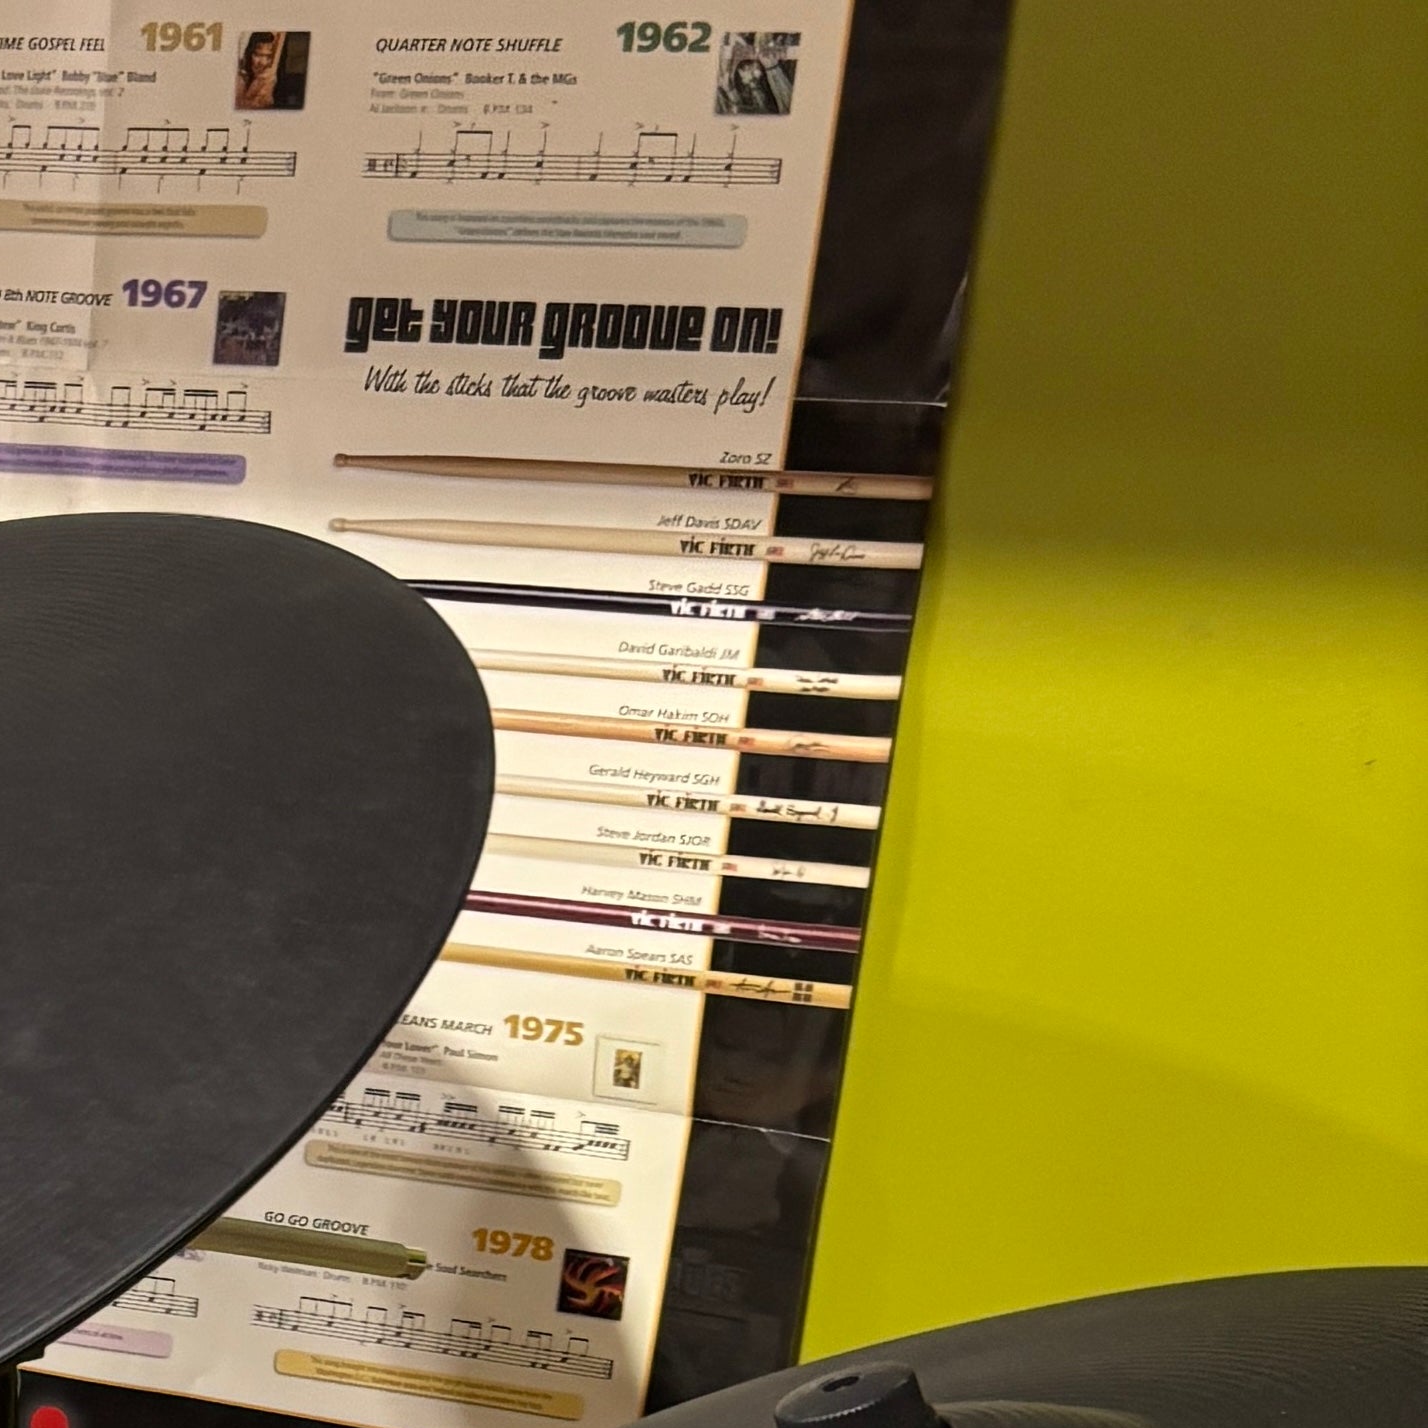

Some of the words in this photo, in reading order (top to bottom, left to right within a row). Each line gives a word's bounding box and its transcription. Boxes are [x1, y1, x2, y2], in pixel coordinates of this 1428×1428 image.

[28, 38, 77, 51] GOSPEL
[79, 38, 106, 52] FEEL
[141, 22, 224, 52] 1961
[376, 38, 447, 53] QUARTER
[450, 38, 493, 53] NOTE
[496, 37, 563, 53] SHUFFLE
[616, 21, 713, 54] 1962
[465, 72, 505, 85] Booker
[25, 290, 59, 304] NOTE
[61, 292, 113, 307] GROOVE
[122, 279, 208, 309] 1967
[364, 364, 408, 393] With
[414, 367, 439, 394] the
[444, 372, 493, 398] sticks
[501, 372, 542, 399] that
[543, 374, 571, 401] the
[575, 381, 637, 408] groove
[643, 378, 708, 407] masters
[714, 376, 777, 415] play!
[618, 641, 655, 655] David
[658, 643, 717, 660] Garibaldi
[619, 705, 654, 717] Omar
[441, 1019, 493, 1036] MARCH
[503, 1013, 585, 1047] 1975
[264, 1211, 285, 1224] GO
[287, 1214, 309, 1227] GO
[312, 1217, 370, 1236] GROOVE
[472, 1227, 555, 1261] 1978
